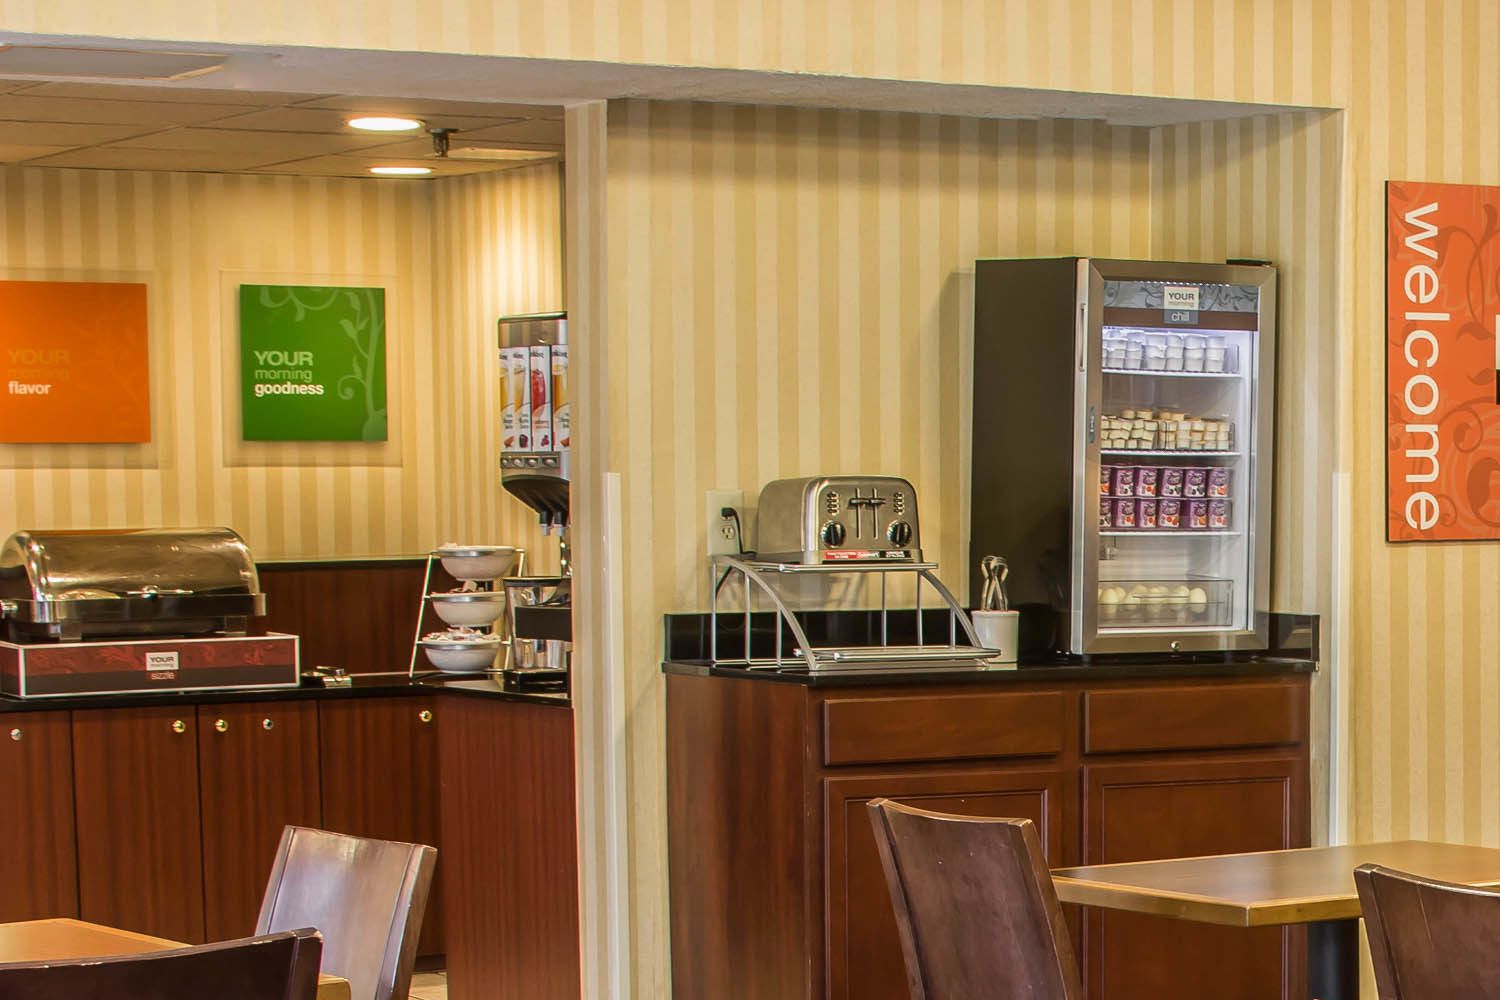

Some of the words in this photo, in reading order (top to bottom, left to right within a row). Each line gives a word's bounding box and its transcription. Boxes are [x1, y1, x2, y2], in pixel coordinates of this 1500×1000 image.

[1168, 292, 1195, 301] YOUR
[253, 350, 314, 367] YOUR
[1404, 202, 1450, 530] welcome
[255, 368, 313, 383] morning
[8, 380, 51, 395] flavor
[254, 381, 325, 398] goodness
